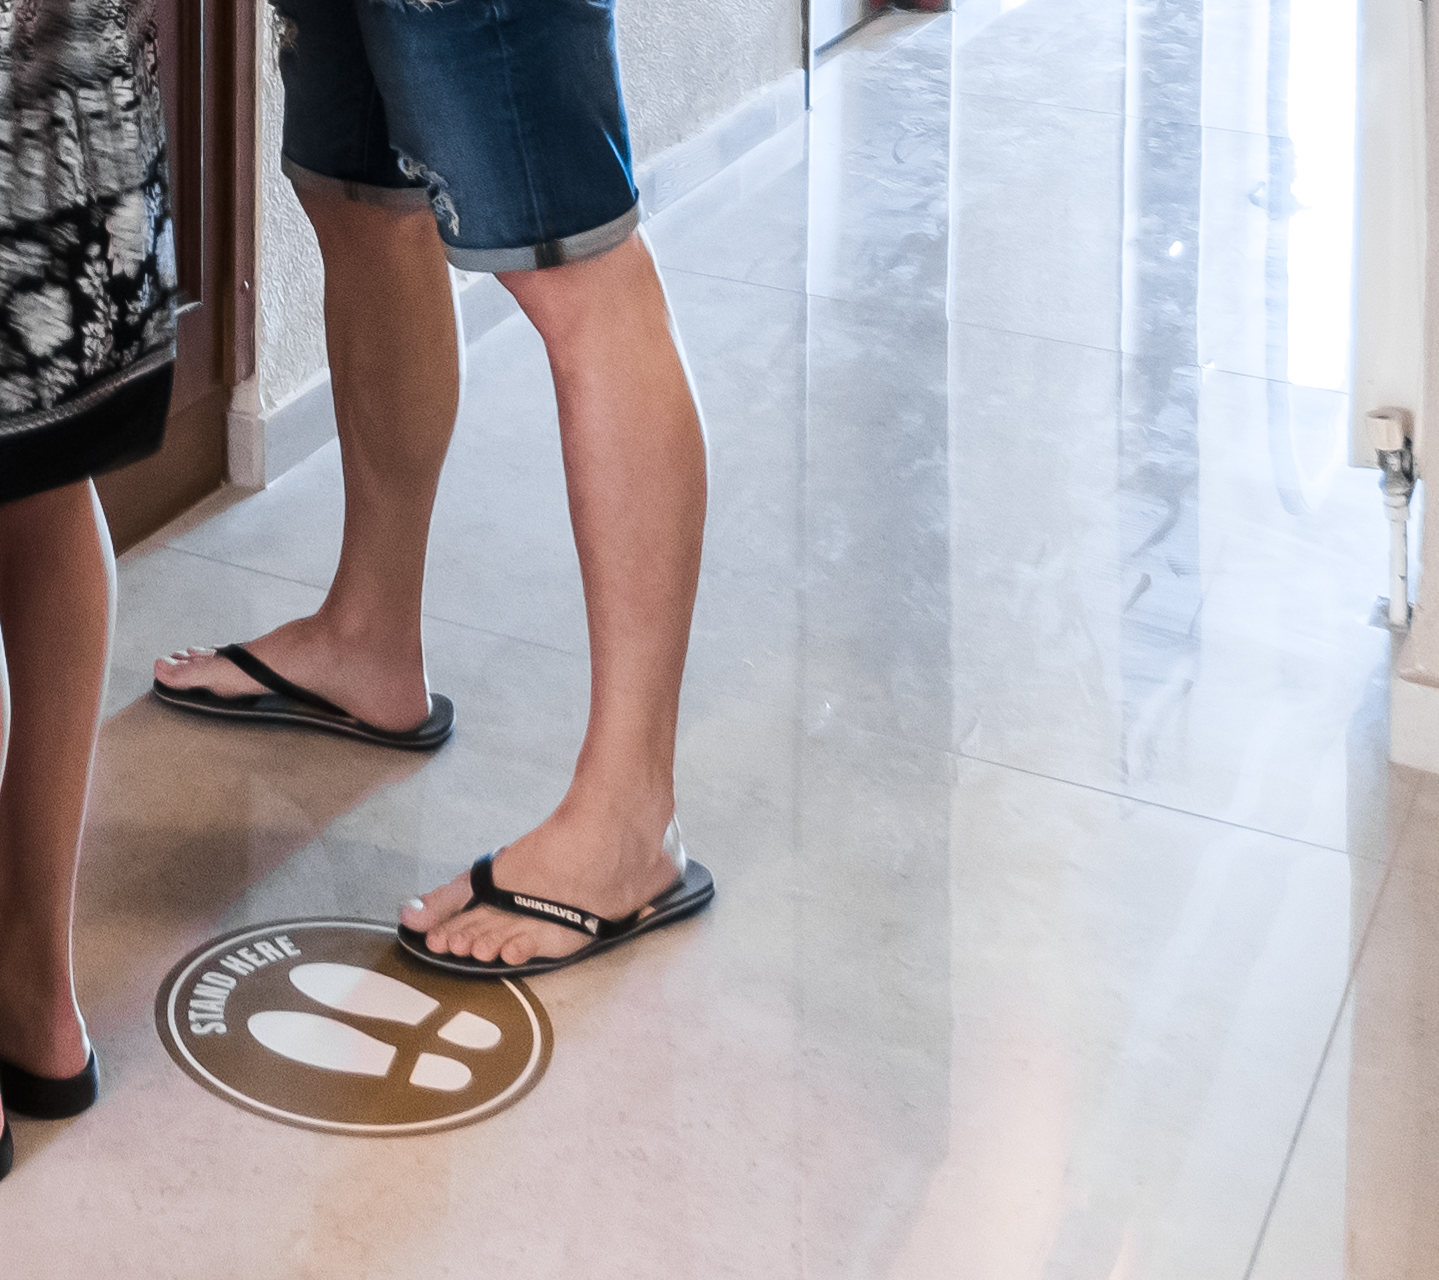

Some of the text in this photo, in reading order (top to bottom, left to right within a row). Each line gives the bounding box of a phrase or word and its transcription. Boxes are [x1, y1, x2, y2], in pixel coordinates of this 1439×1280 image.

[514, 894, 581, 925] QUIKSILVER
[188, 936, 301, 1035] STAND HERE
